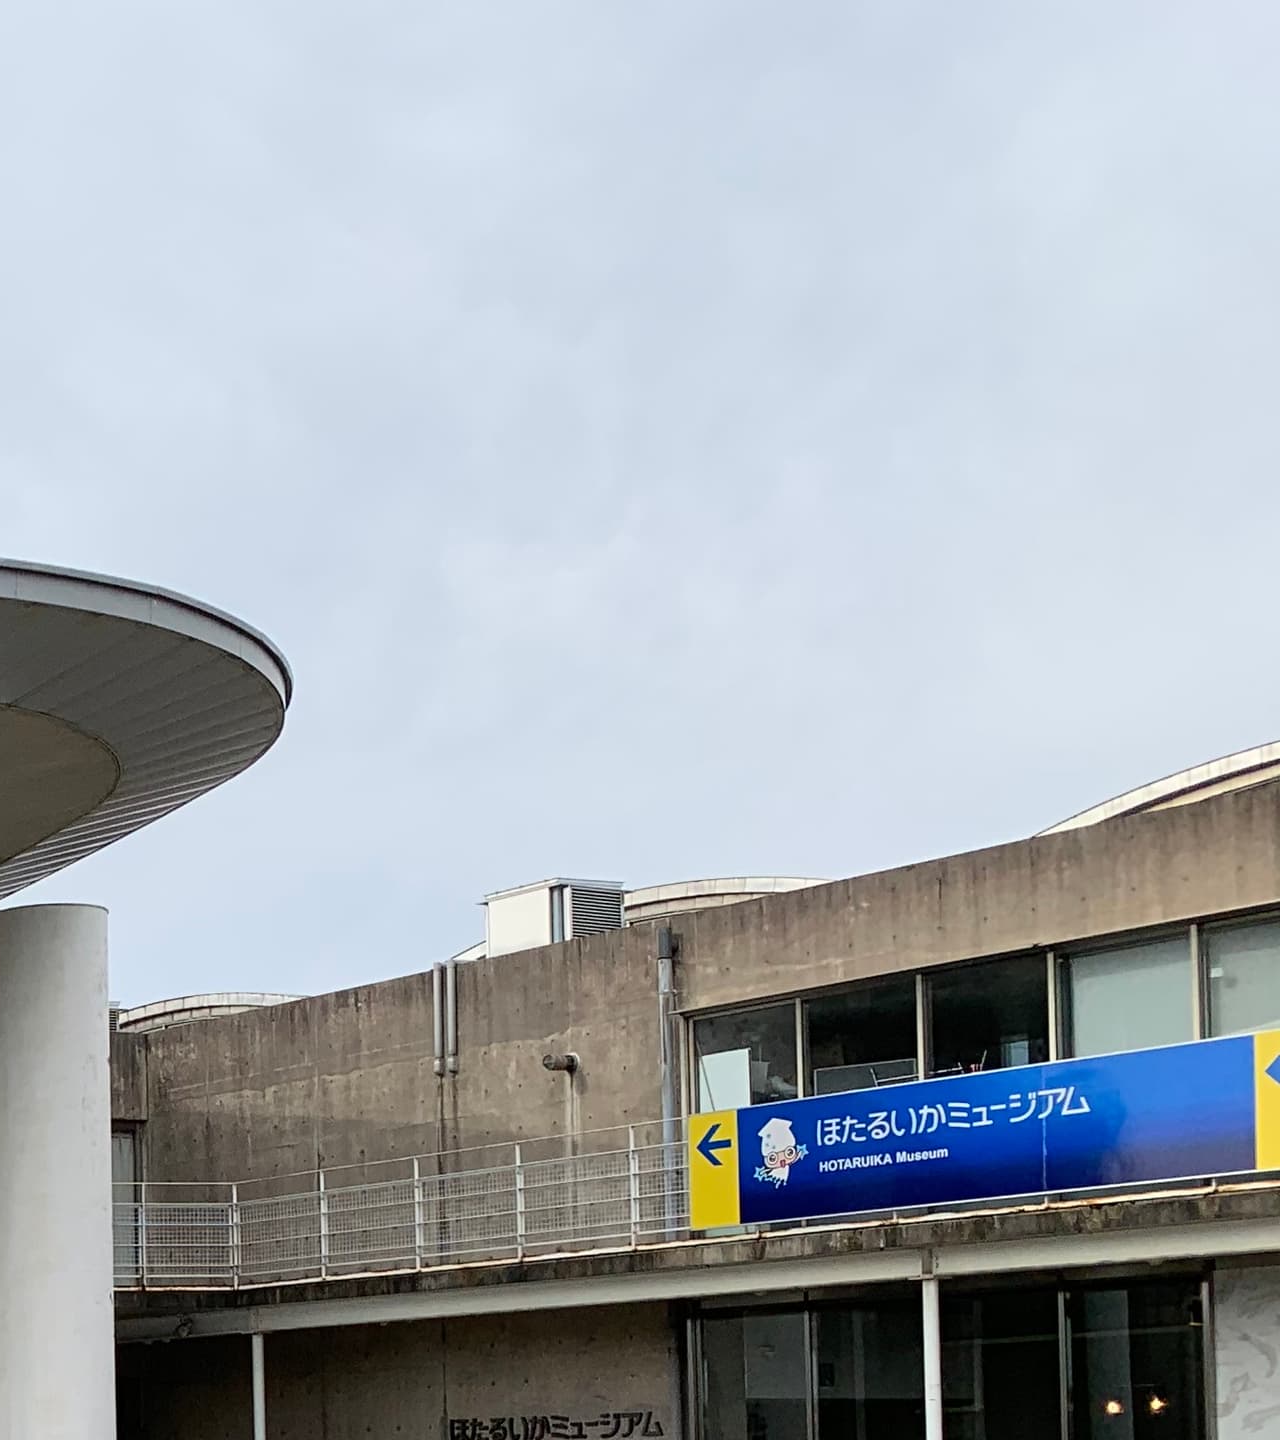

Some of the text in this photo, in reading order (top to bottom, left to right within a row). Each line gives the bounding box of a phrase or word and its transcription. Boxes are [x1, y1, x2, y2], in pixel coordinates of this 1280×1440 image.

[816, 1086, 1091, 1147] ほたるいかミュージアム
[819, 1148, 949, 1173] HOTARUIKA Museum
